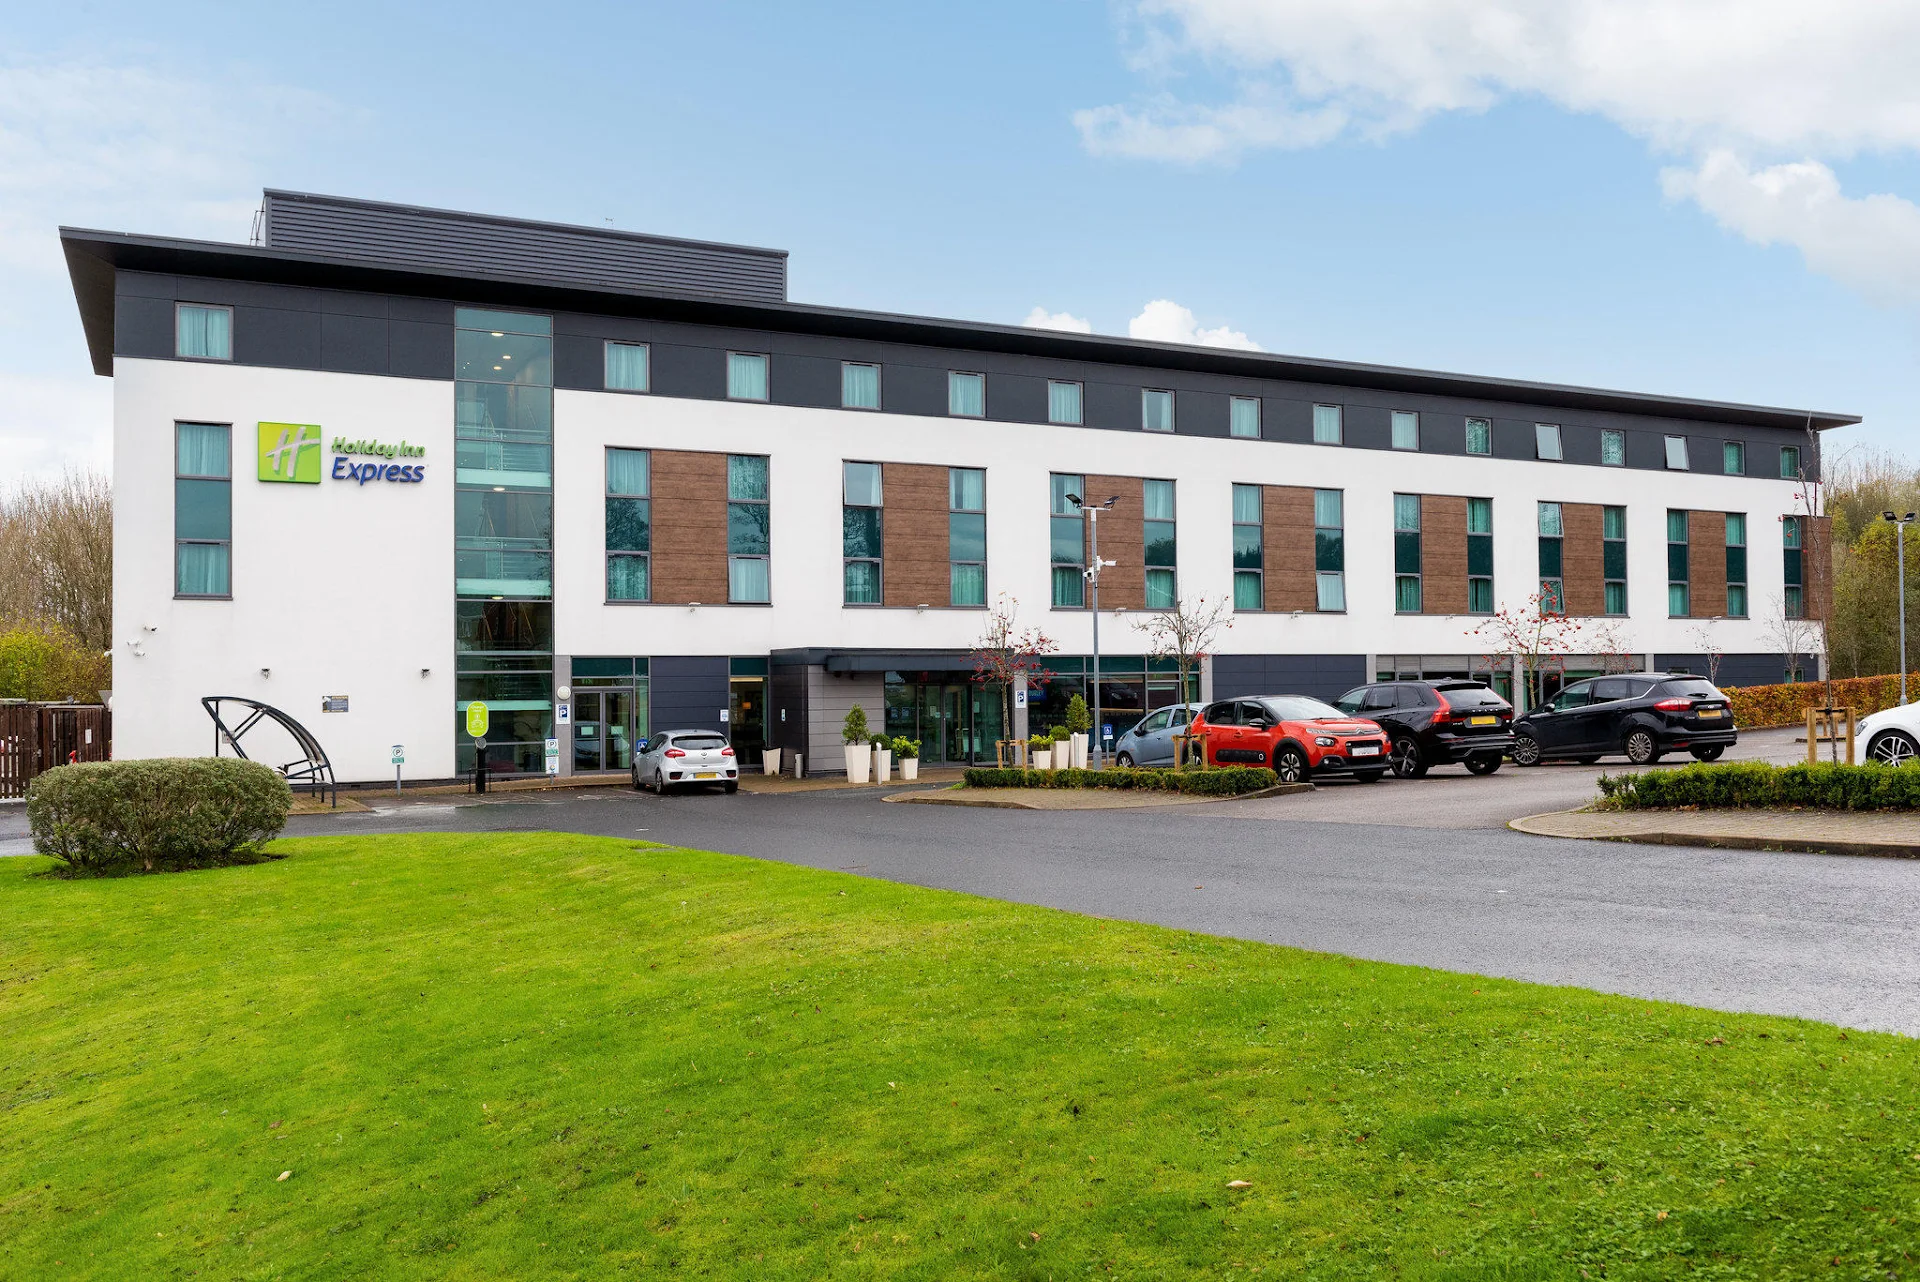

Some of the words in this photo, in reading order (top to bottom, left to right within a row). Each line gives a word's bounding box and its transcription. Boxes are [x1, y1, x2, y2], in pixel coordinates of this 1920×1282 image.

[332, 436, 397, 459] Holiday
[400, 440, 425, 457] Inn
[331, 456, 425, 486] Express
